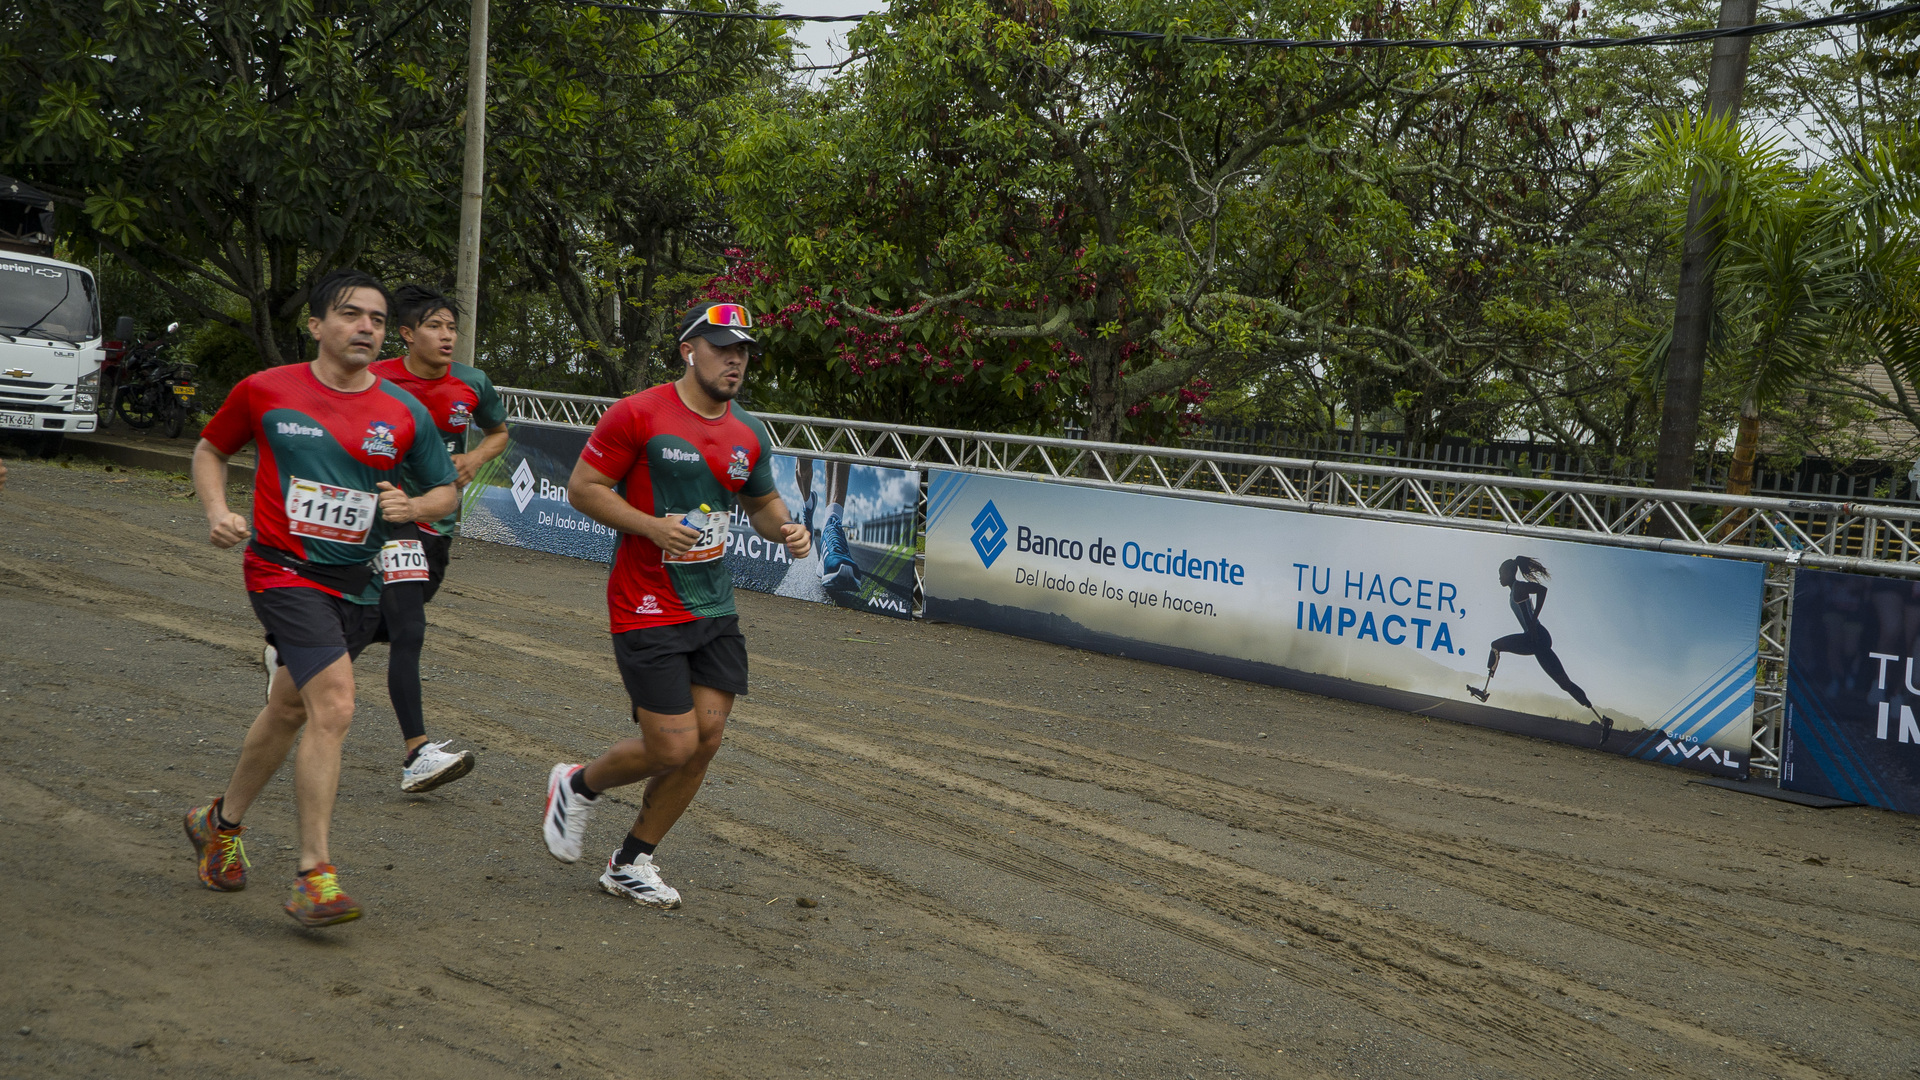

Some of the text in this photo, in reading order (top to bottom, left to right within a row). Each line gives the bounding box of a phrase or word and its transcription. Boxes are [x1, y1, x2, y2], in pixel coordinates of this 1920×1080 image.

[0, 263, 30, 273] erior
[540, 477, 570, 503] Ban
[302, 499, 358, 526] 1115
[538, 511, 554, 526] Del
[556, 513, 576, 530] lado
[578, 517, 590, 532] de
[592, 520, 606, 535] los
[695, 528, 713, 547] 25
[391, 552, 427, 568] 1707
[1017, 525, 1245, 586] Banco de Occidente
[868, 596, 907, 613] AVAL
[1015, 567, 1217, 617] Del lado de los que hacen.
[1293, 563, 1466, 620] TU HACER,
[1296, 601, 1466, 656] IMPACTA.
[1667, 730, 1699, 743] Grupo
[1655, 738, 1740, 769] AVAL
